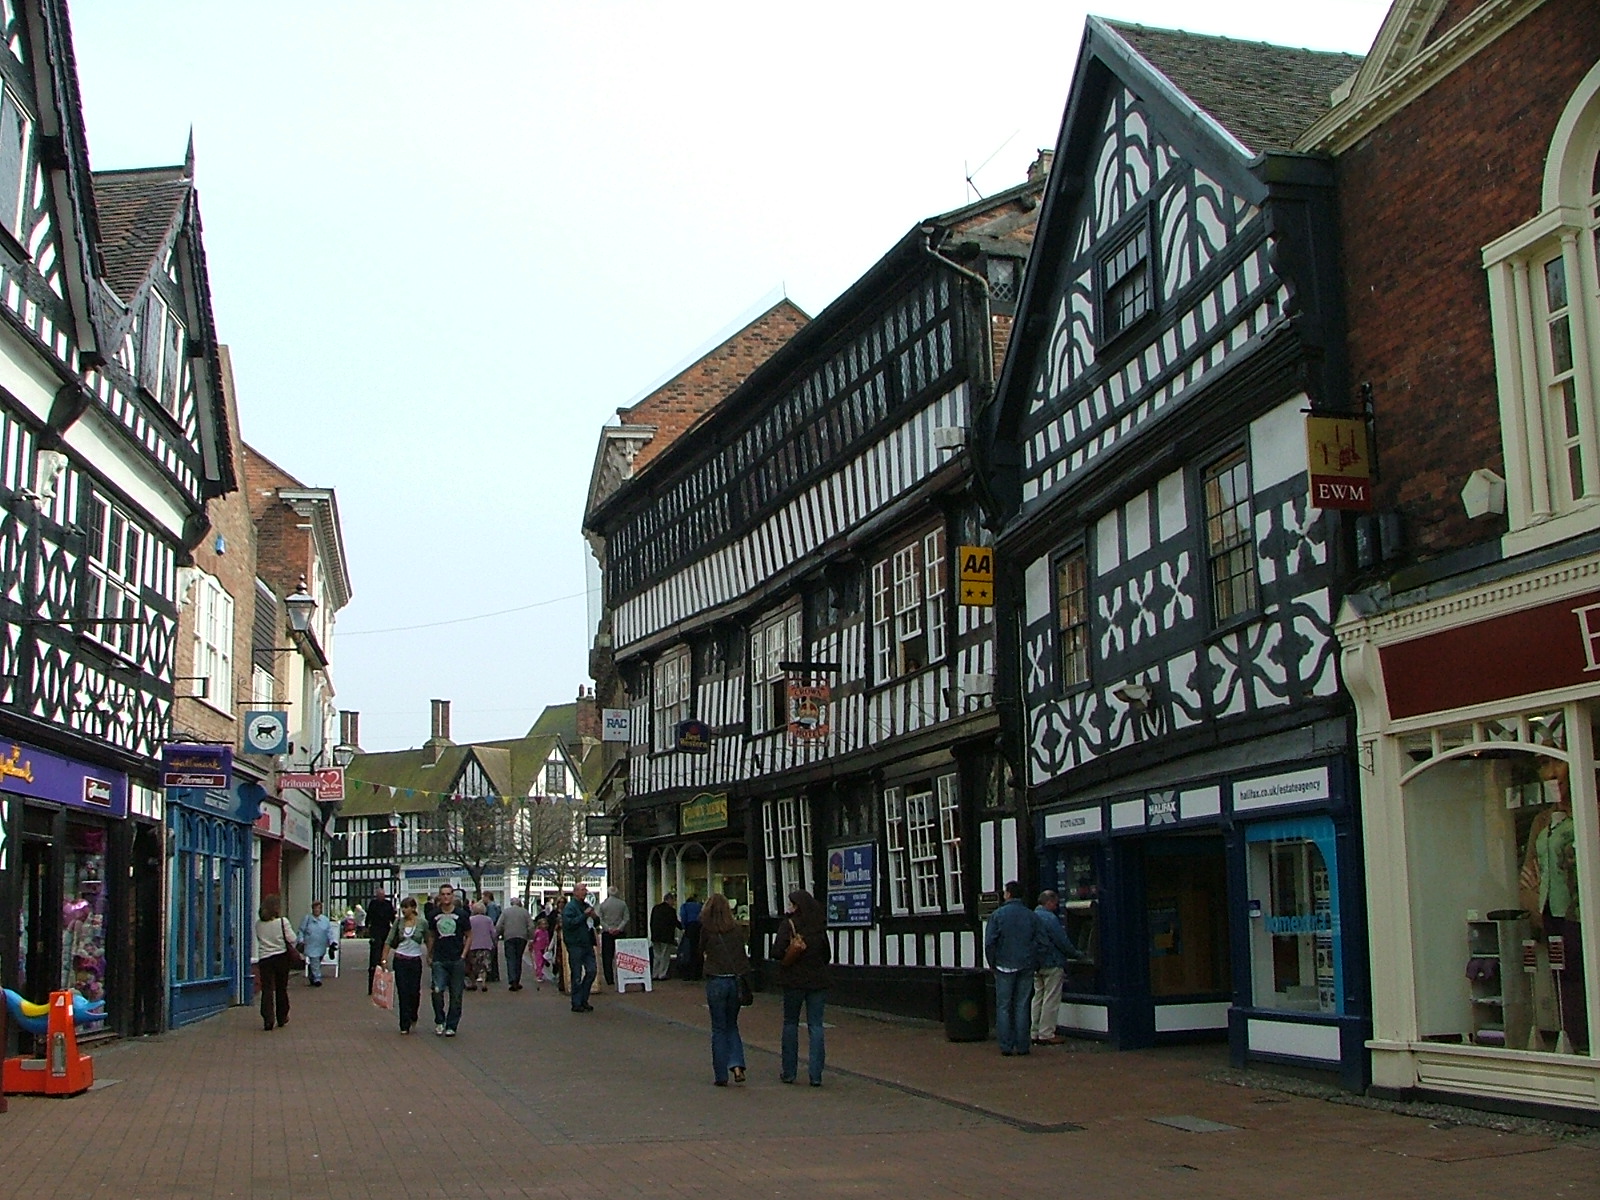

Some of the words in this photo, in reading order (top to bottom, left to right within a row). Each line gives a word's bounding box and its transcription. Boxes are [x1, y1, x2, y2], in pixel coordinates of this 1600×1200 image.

[1319, 483, 1364, 500] EWM
[963, 554, 991, 574] AA
[795, 687, 822, 697] CROWN
[606, 718, 628, 729] RAC
[796, 729, 822, 739] HOTEL
[169, 757, 223, 772] Hallmark
[177, 774, 214, 785] Thorntons
[281, 778, 321, 789] Britannia
[1240, 780, 1321, 801] halifax.co.uk/estateagency
[1148, 801, 1177, 816] HALIFAX
[633, 965, 645, 974] GO
